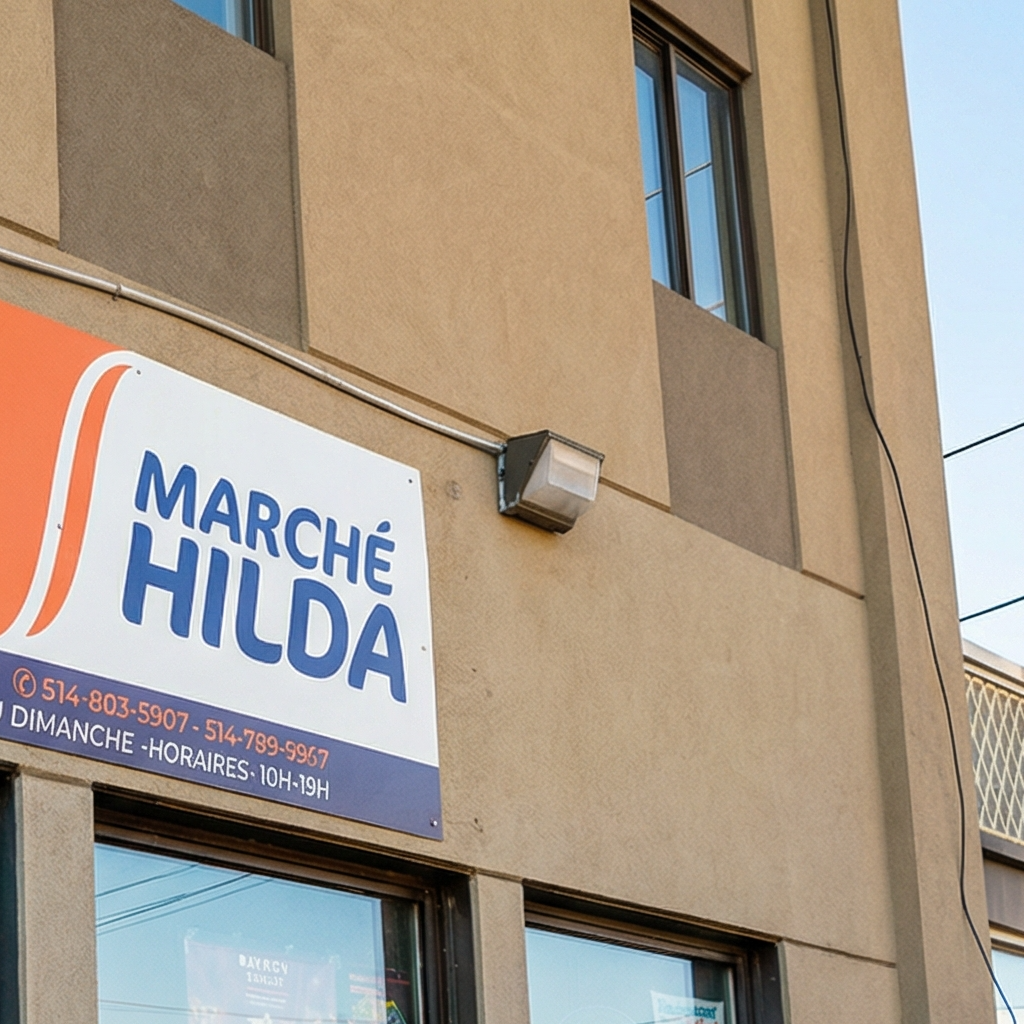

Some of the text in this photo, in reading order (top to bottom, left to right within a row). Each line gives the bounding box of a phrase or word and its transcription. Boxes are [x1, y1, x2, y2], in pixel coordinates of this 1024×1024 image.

[135, 449, 396, 597] MARCHÉ
[122, 521, 408, 704] HILDA
[10, 704, 136, 755] DIMANCHE
[259, 764, 330, 802] 10H-19H
[41, 677, 190, 734] 514-803-5907
